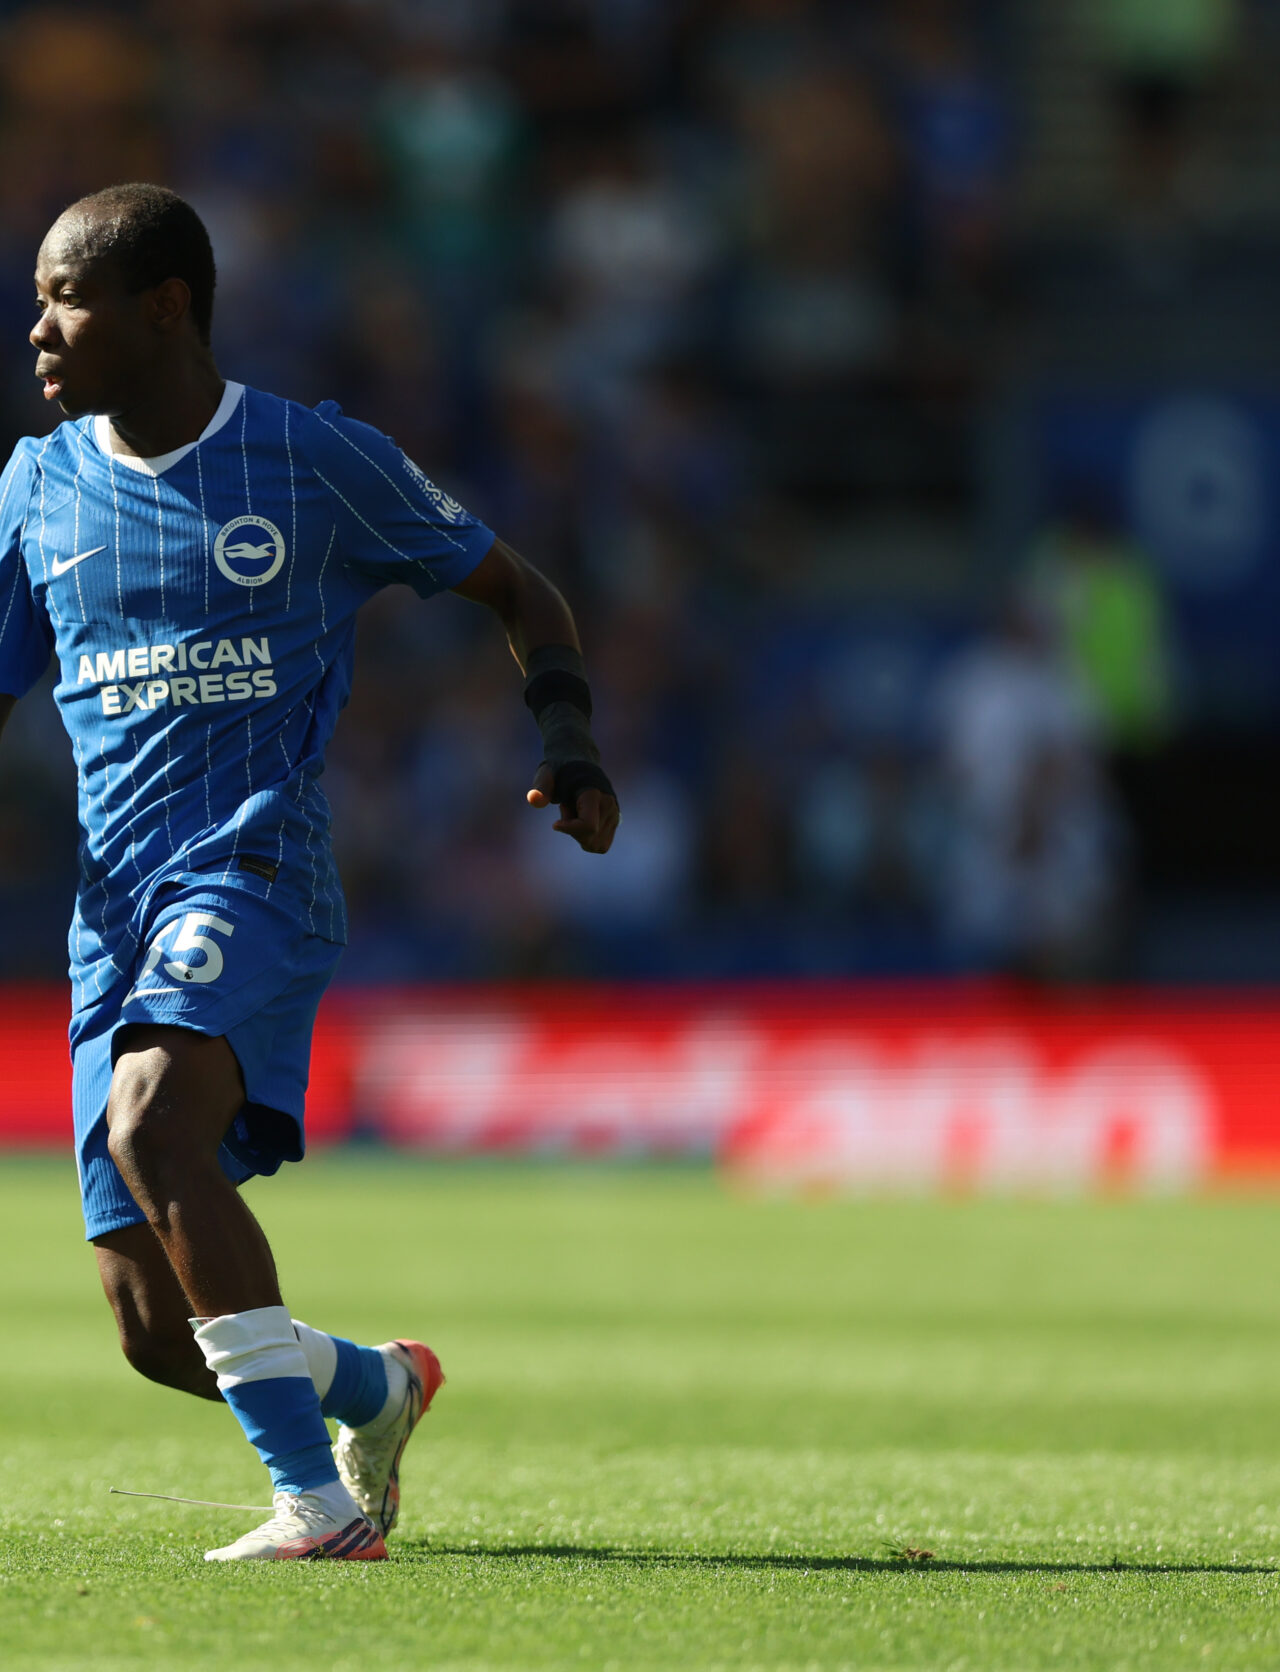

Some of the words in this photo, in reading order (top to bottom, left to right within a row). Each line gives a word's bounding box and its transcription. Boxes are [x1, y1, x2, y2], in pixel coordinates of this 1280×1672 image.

[220, 517, 254, 537] BRIGHTON
[262, 520, 279, 537] HOVE
[236, 577, 263, 585] ALBION
[77, 637, 272, 685] AMERICAN
[100, 669, 278, 715] EXPRESS
